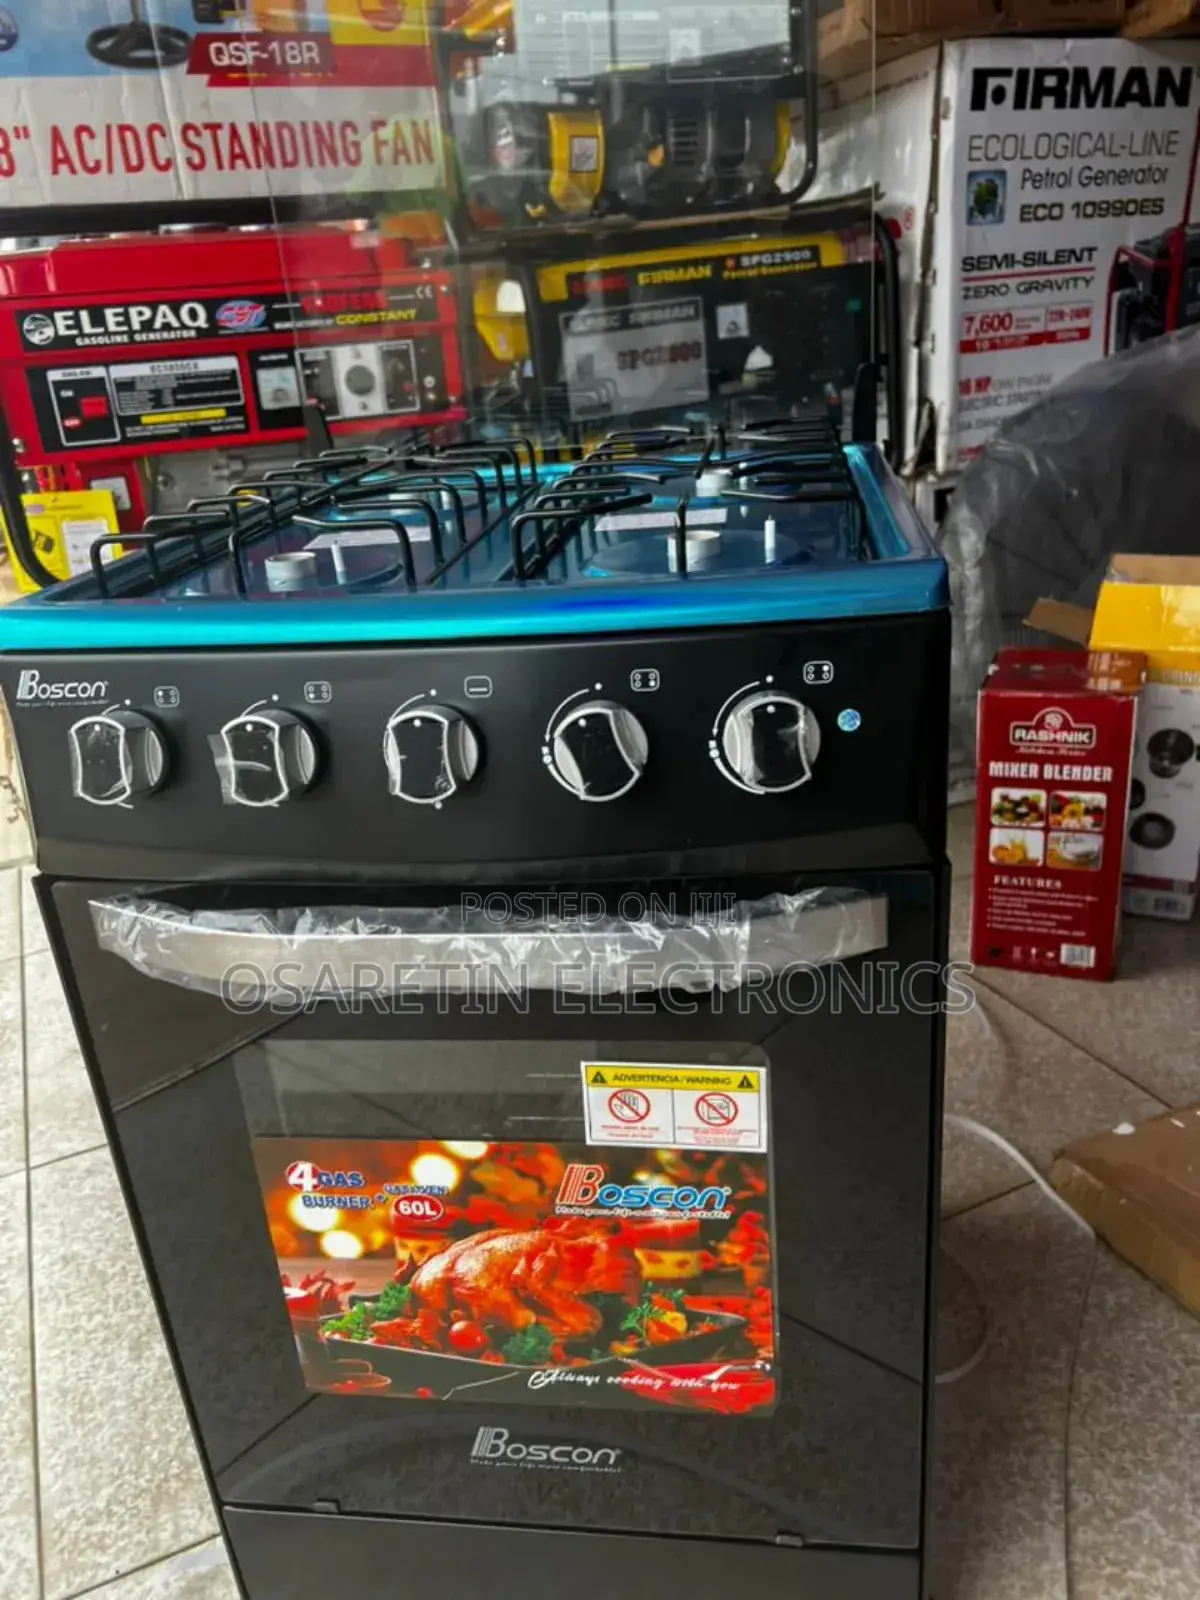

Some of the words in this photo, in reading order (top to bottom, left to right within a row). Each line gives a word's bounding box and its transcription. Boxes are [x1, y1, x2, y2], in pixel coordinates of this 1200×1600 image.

[208, 40, 321, 68] QSF-18R
[970, 65, 1193, 112] FIRMAN
[50, 122, 174, 177] AC/DC
[180, 119, 363, 173] STANDING
[370, 118, 435, 167] FAN
[967, 130, 1180, 163] ECOLOGICAL-LINE
[1020, 165, 1073, 191] Petrol
[1077, 163, 1169, 188] Generator
[1019, 202, 1064, 223] ECO
[961, 246, 1098, 273] SEMI-SILENT
[962, 282, 1010, 301] ZERO
[1015, 275, 1094, 297] GRAVITY
[53, 301, 209, 336] ELEPAQ
[963, 311, 1013, 337] 7,600
[75, 332, 130, 346] GASOLINE
[134, 328, 198, 343] GENERATOR
[16, 669, 109, 701] Boscon
[1014, 726, 1092, 745] RASHNIK
[988, 760, 1039, 779] MIXER
[1043, 762, 1113, 783] BLENDER
[993, 874, 1062, 890] FEATURES
[612, 1073, 680, 1084] ADVERTENCIA
[287, 1161, 319, 1192] 4
[317, 1171, 364, 1188] GAS
[556, 1163, 728, 1210] Boscon
[302, 1195, 373, 1209] BURNER
[398, 1199, 438, 1216] 60L
[527, 1368, 600, 1389] Always
[709, 1379, 741, 1393] you
[470, 1425, 620, 1465] Boscon
